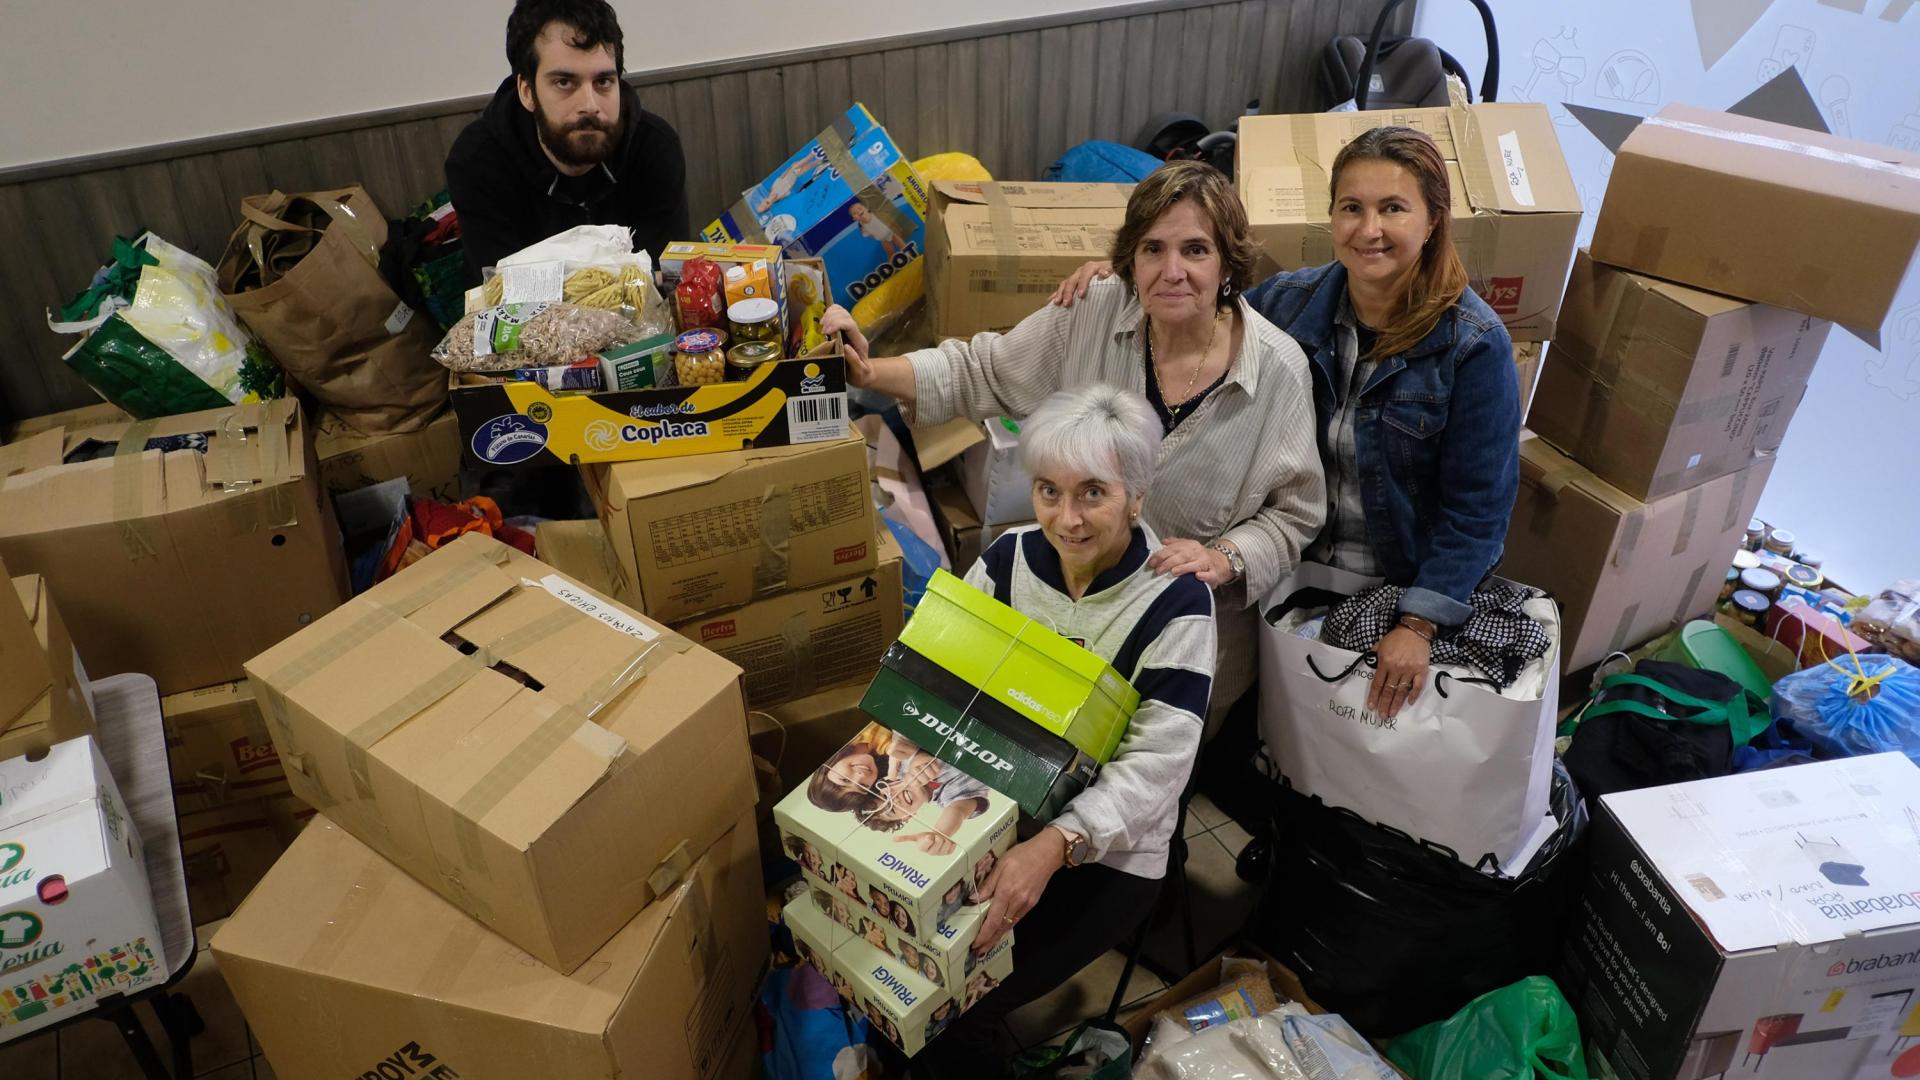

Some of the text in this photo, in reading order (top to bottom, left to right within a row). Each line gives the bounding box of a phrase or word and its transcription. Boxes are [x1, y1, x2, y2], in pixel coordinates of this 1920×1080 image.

[847, 241, 920, 300] DODOT
[645, 401, 678, 416] sabor
[679, 400, 695, 412] de
[621, 420, 708, 444] Coplaca
[1007, 687, 1042, 713] adidas
[1329, 699, 1398, 731] ROPA MUJER
[918, 712, 1014, 773] DUNLOP
[988, 815, 1015, 844] PRIMIGI
[876, 852, 932, 889] PRIMIGI
[882, 881, 914, 908] PRIMIGI
[1637, 867, 1672, 916] brabantia
[1819, 892, 1919, 921] brabantia
[1610, 870, 1620, 883] Hi
[1643, 916, 1658, 937] am
[1656, 931, 1673, 955] Bo!
[0, 940, 65, 970] ería
[1597, 916, 1614, 945] Touch
[1612, 940, 1625, 959] Bin
[1622, 955, 1641, 984] that's
[1639, 981, 1669, 1022] designed
[872, 965, 918, 1007] PRIMIGI
[1610, 955, 1620, 971] for
[1618, 971, 1633, 992] your
[1631, 985, 1651, 1018] home
[1613, 982, 1625, 997] our
[1622, 995, 1645, 1029] planet.
